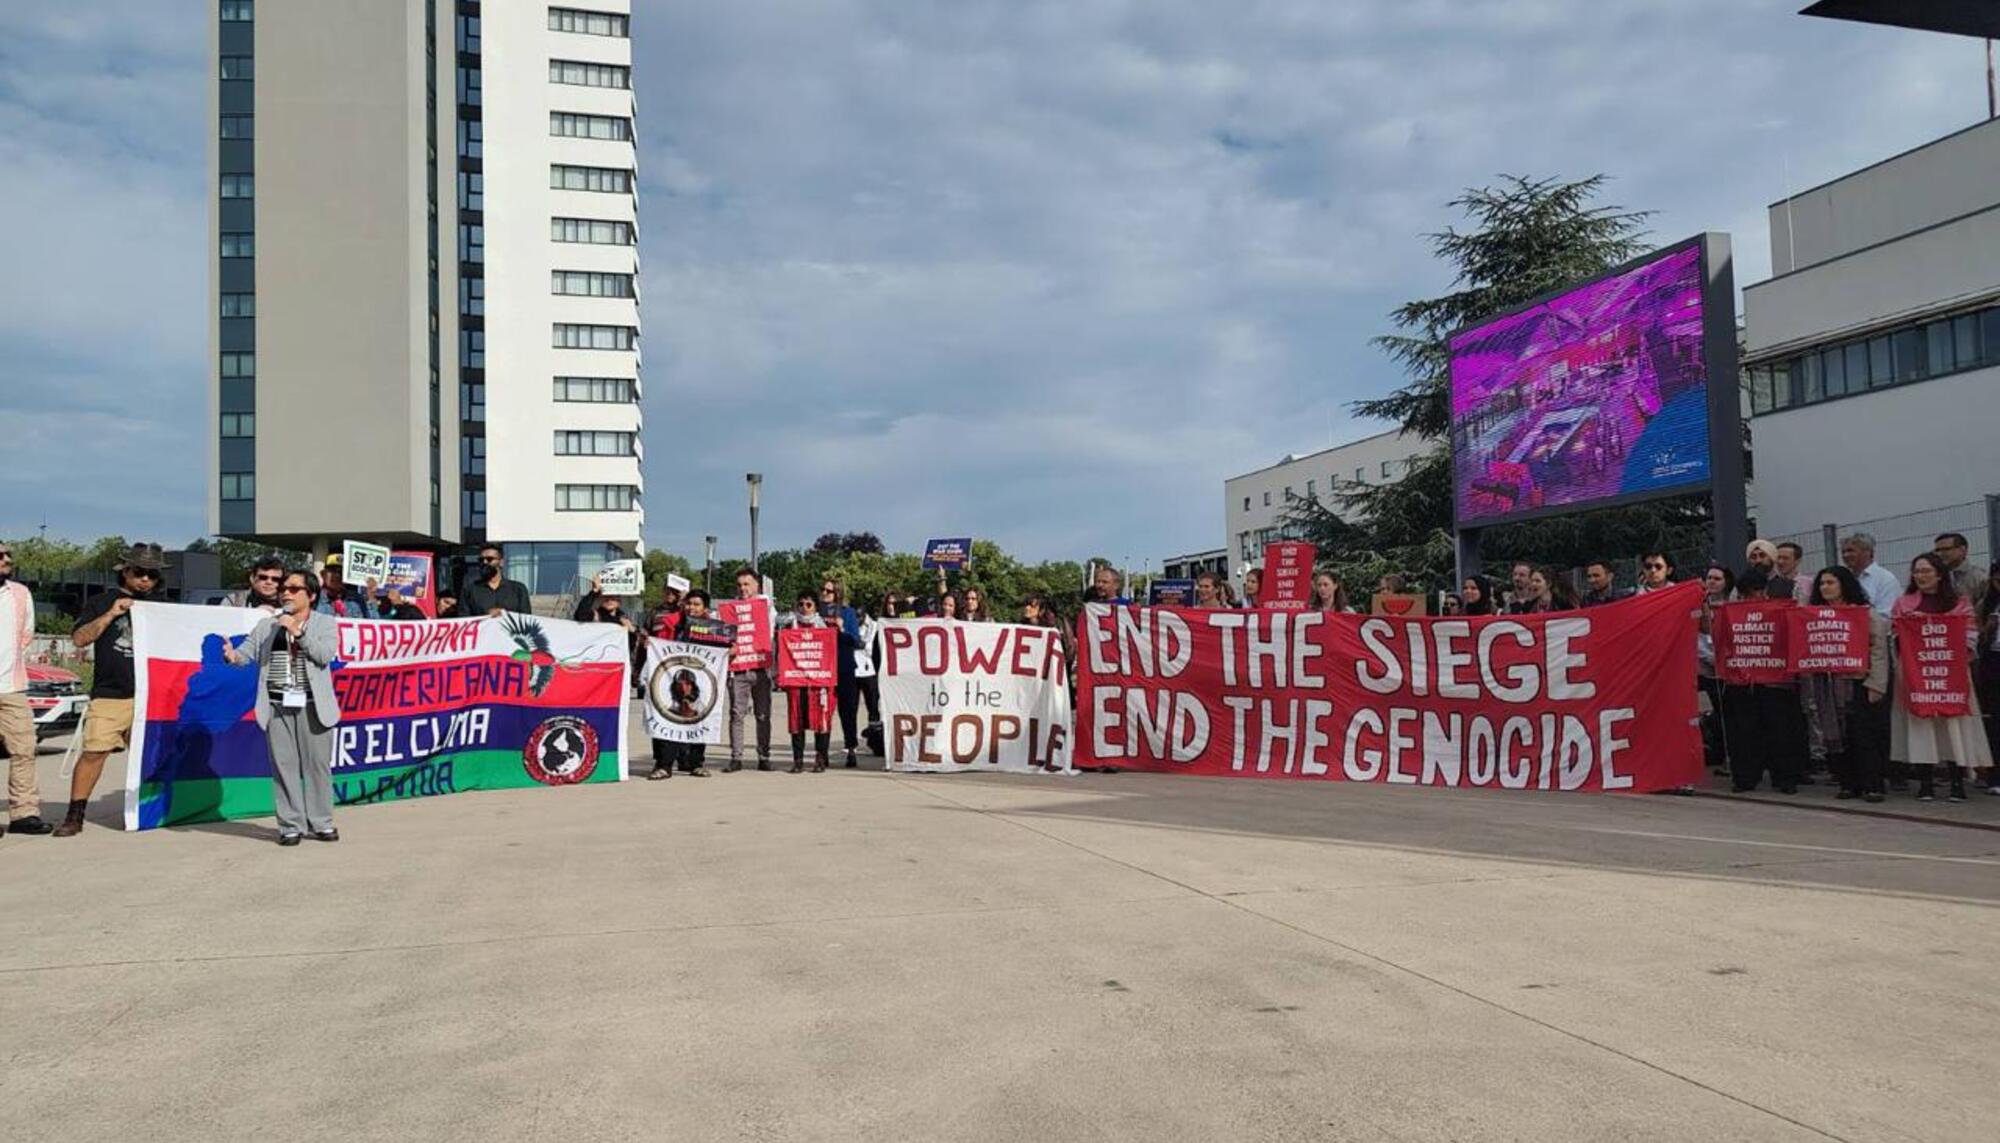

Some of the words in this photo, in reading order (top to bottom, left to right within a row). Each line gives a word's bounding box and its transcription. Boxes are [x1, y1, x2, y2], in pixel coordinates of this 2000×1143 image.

[1747, 612, 1763, 622] NO
[1818, 610, 1835, 618] NO
[1732, 623, 1776, 632] CLIMATE
[1806, 621, 1850, 630] CLIMATE
[1921, 624, 1948, 636] END
[337, 619, 481, 661] CARAVANA
[1733, 634, 1774, 643] JUSTICE
[1808, 632, 1850, 642] JUSTICE
[1922, 637, 1948, 648] THE
[1085, 602, 1192, 678] END
[1209, 611, 1326, 688] THE
[1355, 617, 1597, 703] SIEGE
[1736, 645, 1771, 655] UNDER
[1810, 645, 1846, 654] UNDER
[883, 626, 1066, 687] POWER
[1917, 650, 1954, 661] SIEGE
[1798, 658, 1862, 667] OCCUPATION
[1922, 666, 1948, 677] END
[334, 661, 524, 711] SOAMERICANA
[1923, 679, 1948, 690] THE
[931, 682, 949, 707] to
[965, 681, 1002, 708] the
[1910, 692, 1966, 703] GENOCIDE
[365, 723, 403, 764] EL
[893, 714, 1066, 771] PEOPLE
[1094, 685, 1210, 763] END
[1223, 696, 1333, 775] THE
[1343, 707, 1635, 791] GENOCIDE
